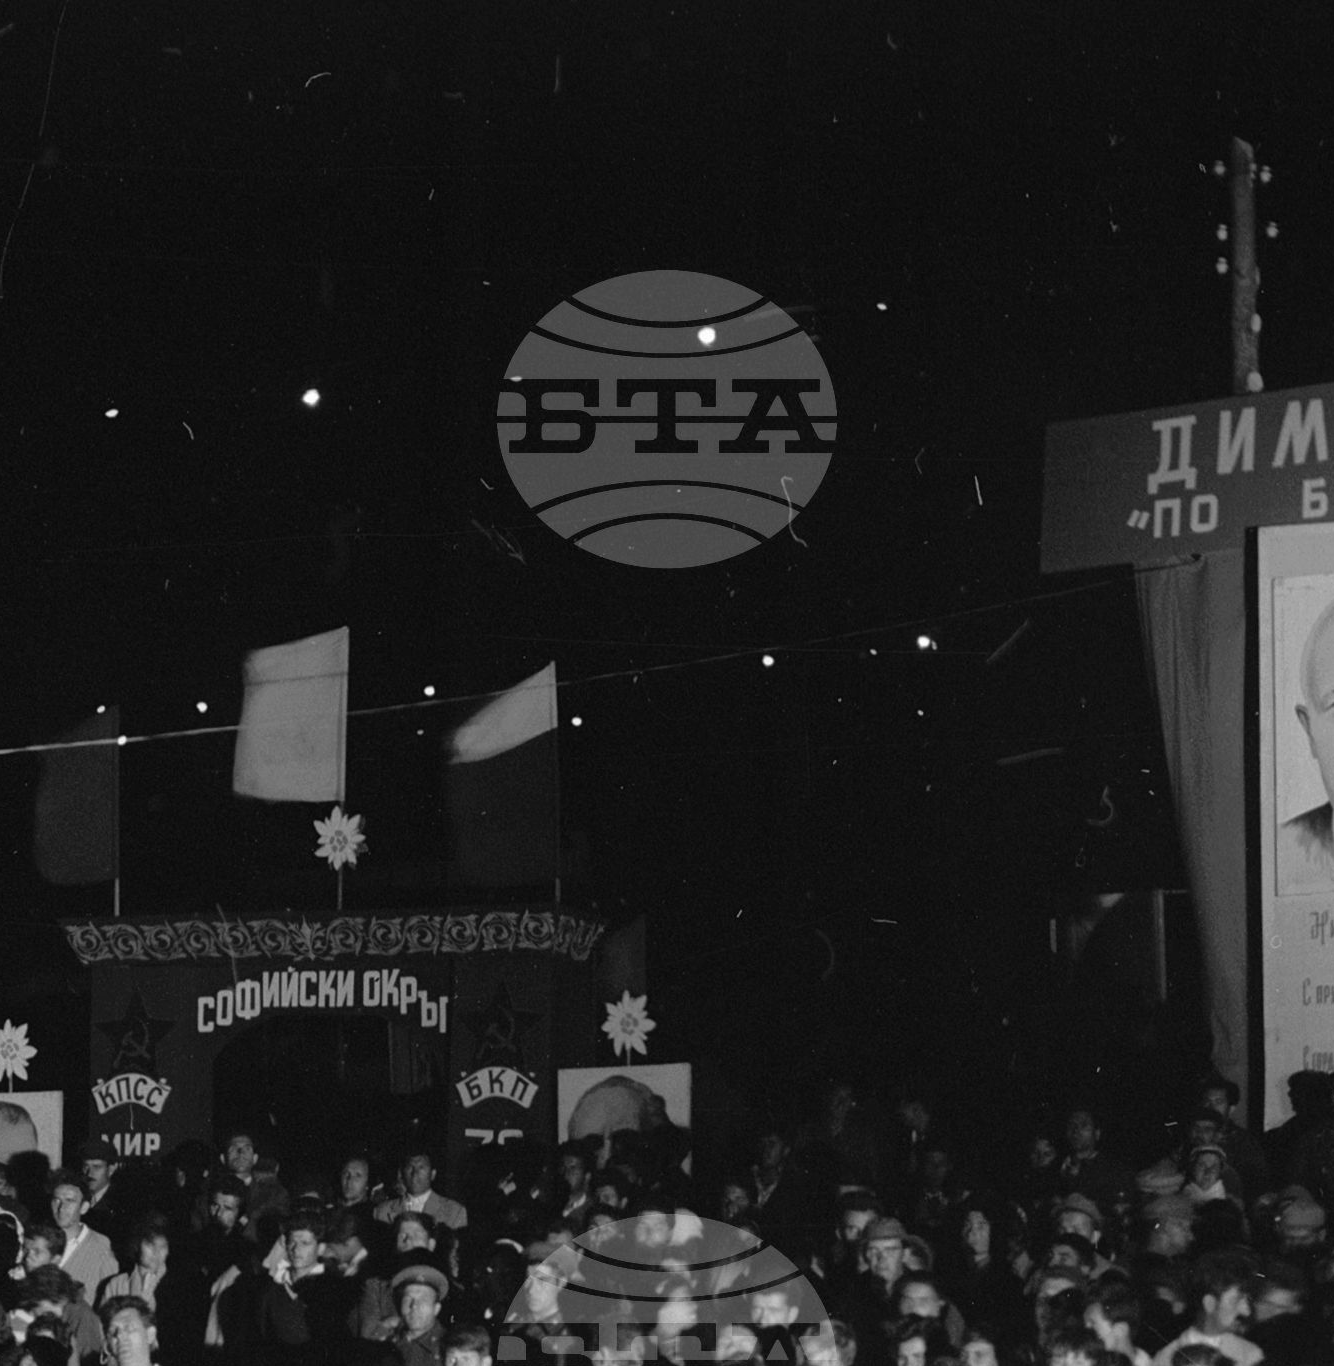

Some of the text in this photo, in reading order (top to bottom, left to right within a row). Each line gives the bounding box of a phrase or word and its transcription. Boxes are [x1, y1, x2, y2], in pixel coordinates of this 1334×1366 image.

[197, 965, 355, 1033] СОФИЙСКИ
[1301, 977, 1312, 1006] С
[97, 1076, 163, 1109] КПСС
[464, 1069, 530, 1101] БКП
